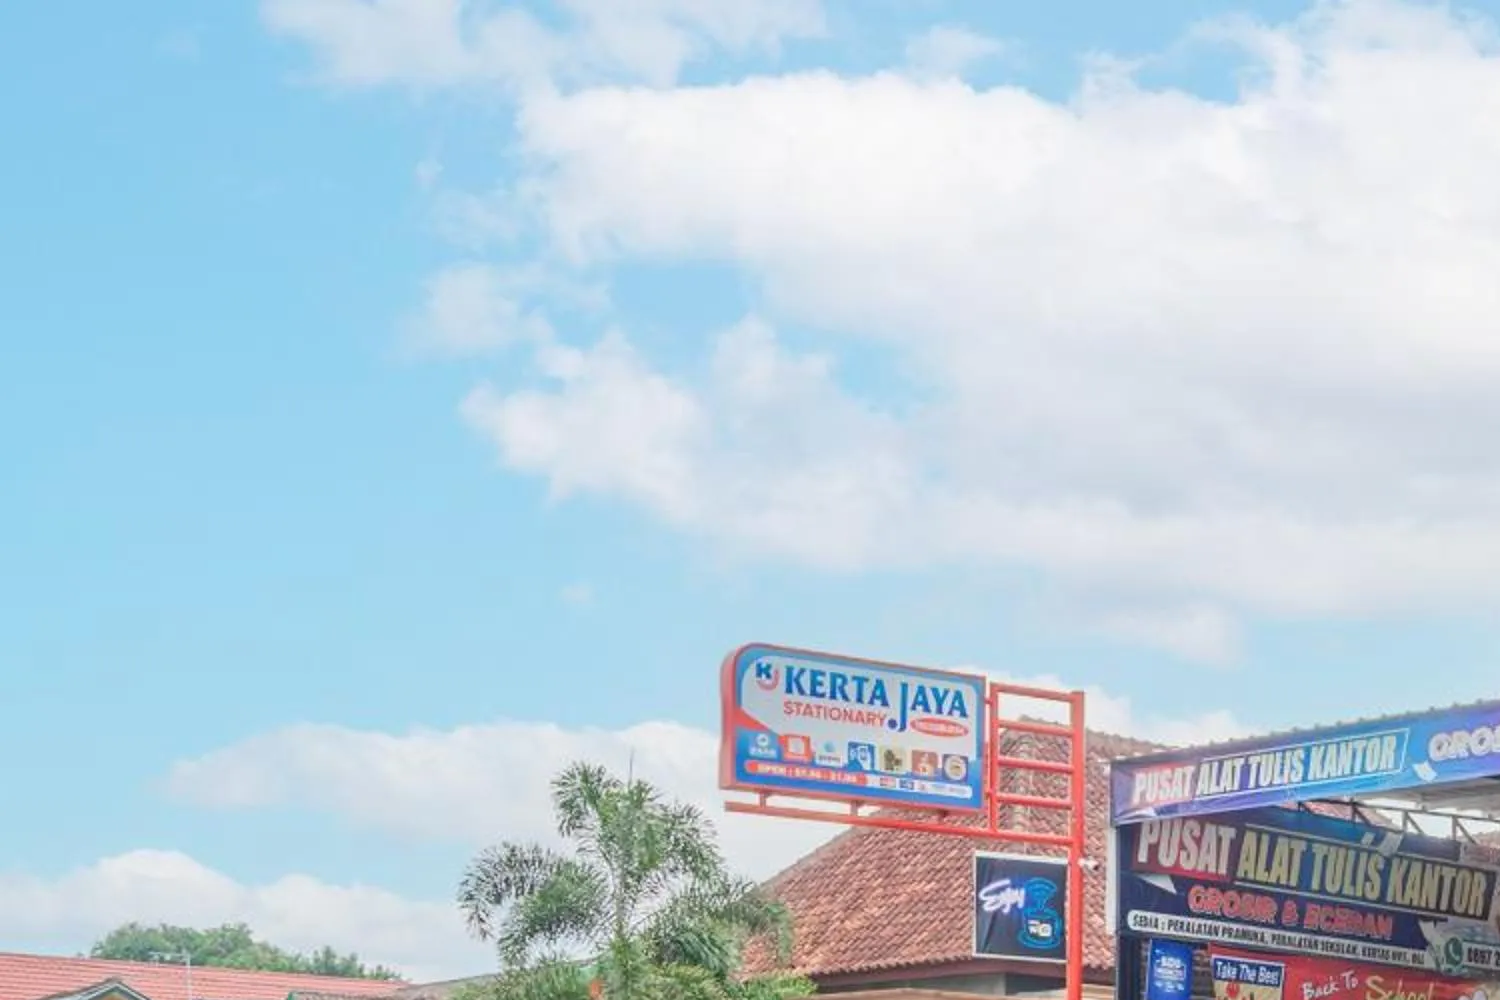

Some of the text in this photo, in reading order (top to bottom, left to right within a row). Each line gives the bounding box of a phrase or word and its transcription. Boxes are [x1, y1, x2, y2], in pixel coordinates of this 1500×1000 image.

[784, 700, 887, 727] STATIONARY
[785, 665, 889, 707] KERTA
[898, 682, 968, 732] JAYA
[1133, 766, 1196, 803] PUSAT
[1196, 757, 1244, 795] ALAT
[1248, 748, 1303, 787] TULIS
[1307, 734, 1398, 781] KANTOR
[1137, 820, 1489, 917] PUSAT ALAT TULIS KANTOR
[1167, 919, 1219, 937] PERALATAN
[1188, 885, 1278, 924] GROSIR
[1304, 902, 1392, 940] ECERAN
[1216, 961, 1237, 979] Take
[1239, 964, 1257, 981] The
[1302, 981, 1339, 1000] Back
[1342, 970, 1358, 989] To
